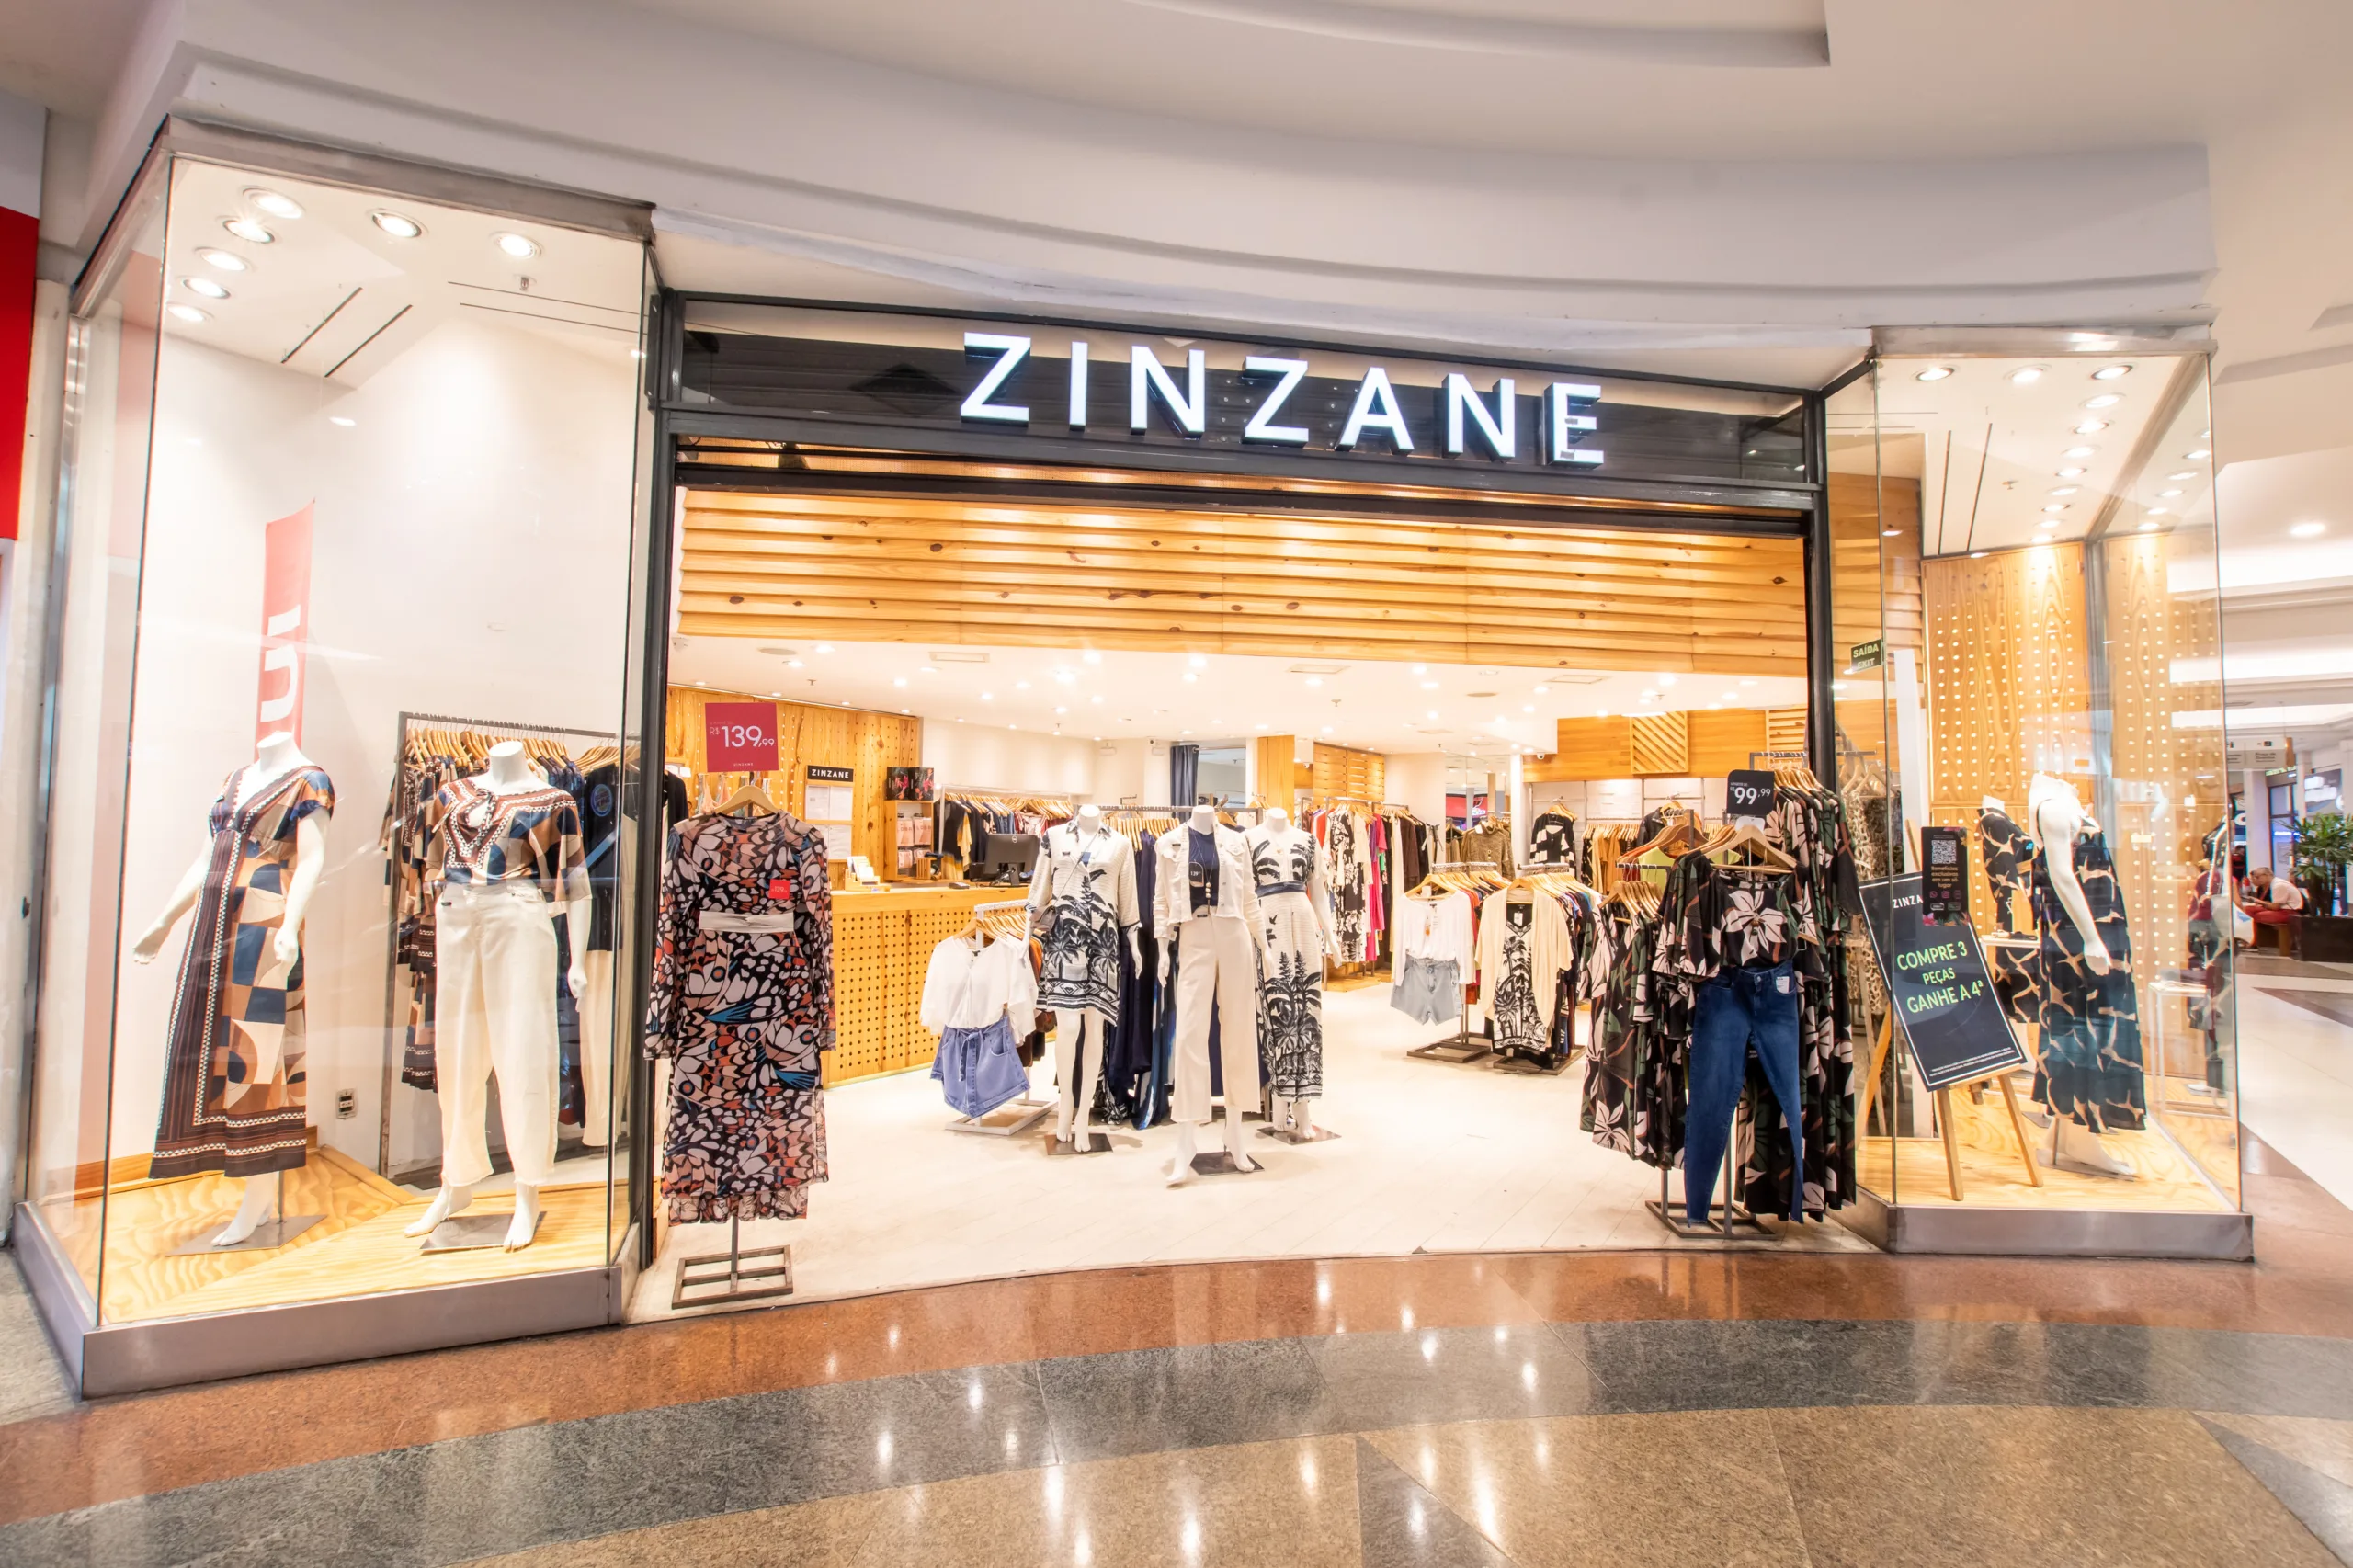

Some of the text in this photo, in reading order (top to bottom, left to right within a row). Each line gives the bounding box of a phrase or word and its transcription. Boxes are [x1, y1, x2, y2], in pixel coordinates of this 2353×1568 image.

[960, 332, 1605, 467] ZINZANE
[1853, 643, 1879, 658] SAÍDA
[1858, 658, 1875, 668] EXIT
[709, 725, 775, 748] R$ 139,99
[811, 768, 849, 779] ZINZANE
[1734, 787, 1771, 805] 99,99
[1892, 894, 1924, 909] ZINZA
[1896, 940, 1968, 971] COMPRE 3
[1922, 967, 1956, 985] PEÇAS
[1906, 980, 1984, 1013] GANHE A 4ª
